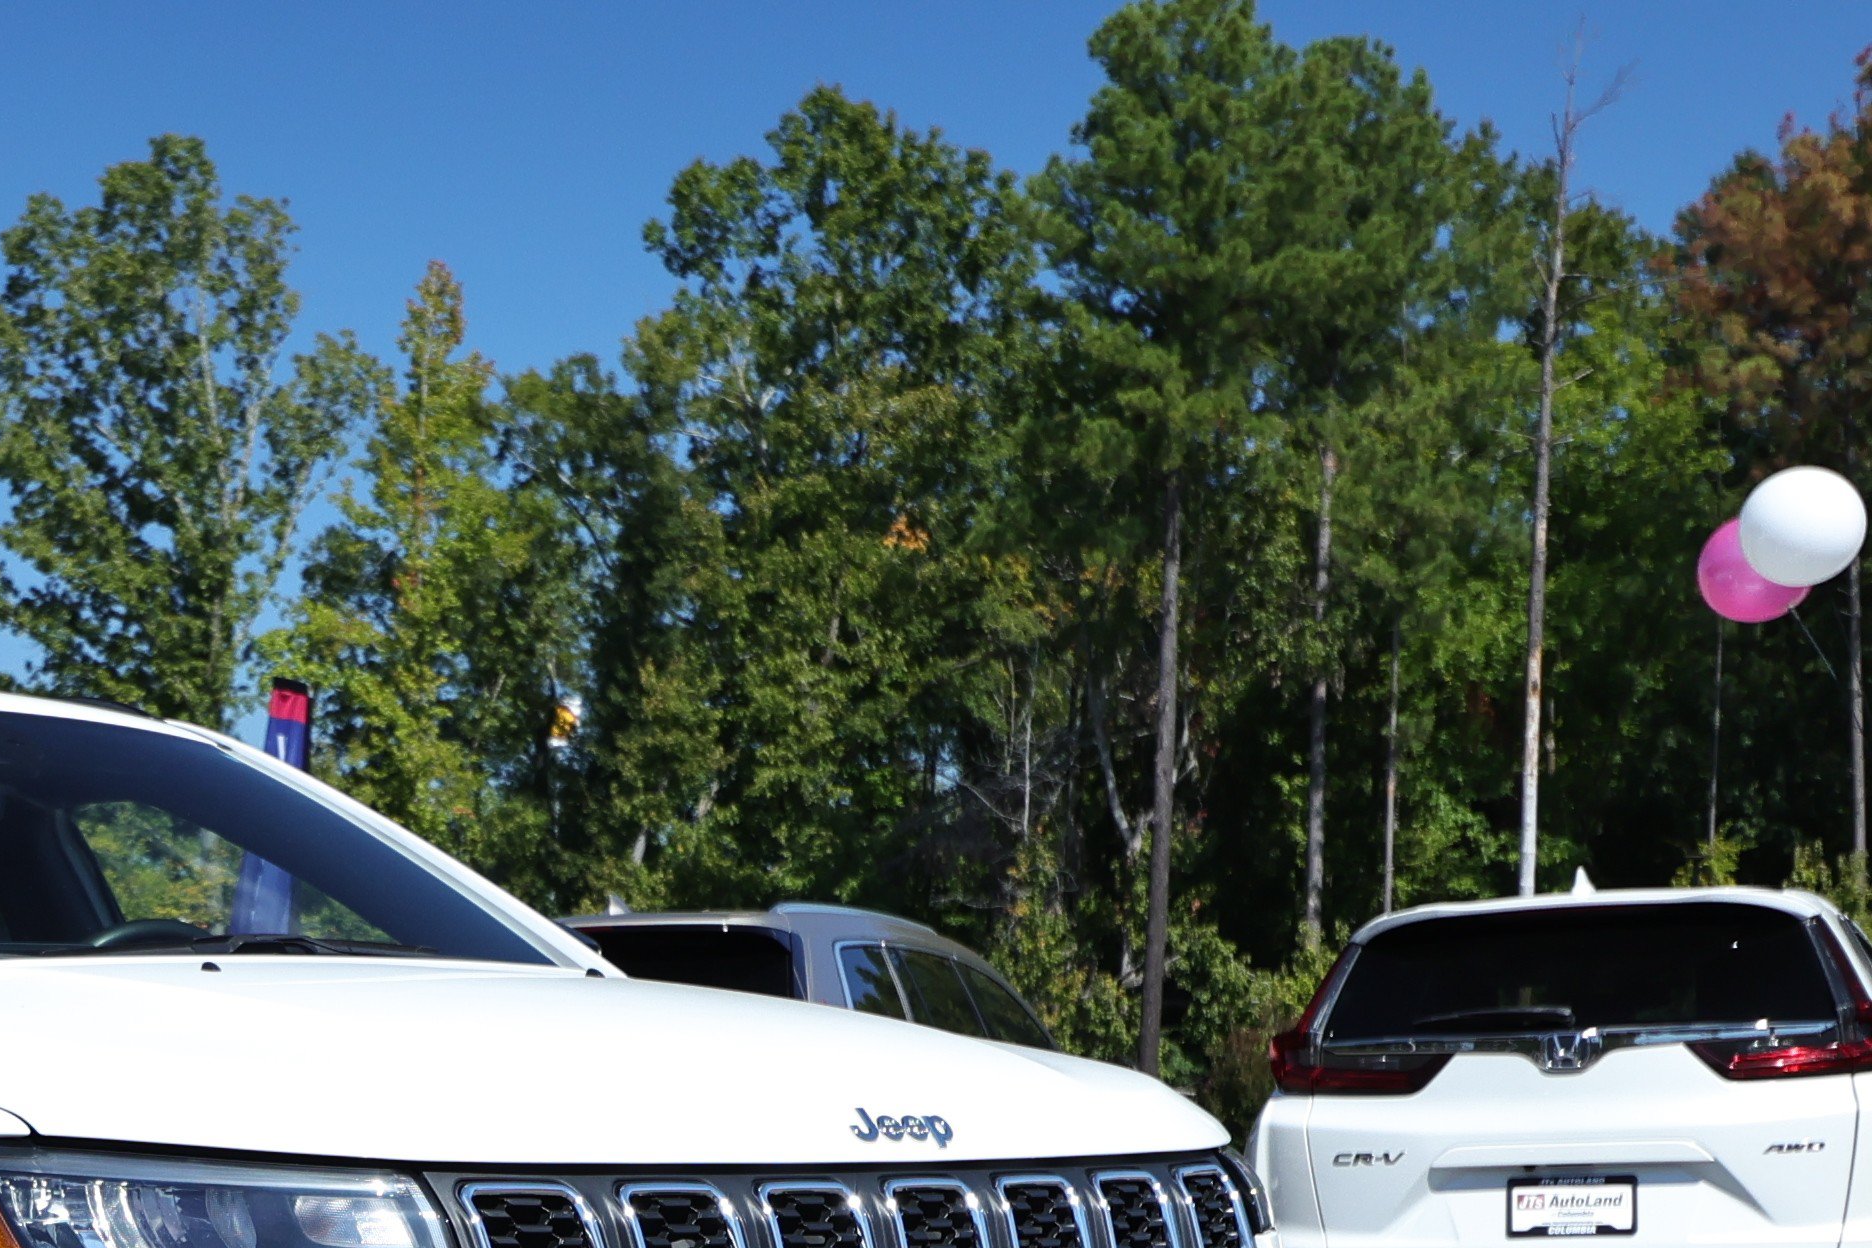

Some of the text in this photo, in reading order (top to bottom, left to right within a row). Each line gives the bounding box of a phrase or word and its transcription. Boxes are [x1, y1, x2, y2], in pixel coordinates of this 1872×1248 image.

[849, 1107, 954, 1150] Jeep
[1762, 1142, 1826, 1155] AWD
[1332, 1151, 1405, 1168] CR-V
[1549, 1194, 1623, 1208] AutoLand
[1548, 1227, 1596, 1235] COLUMBIA
